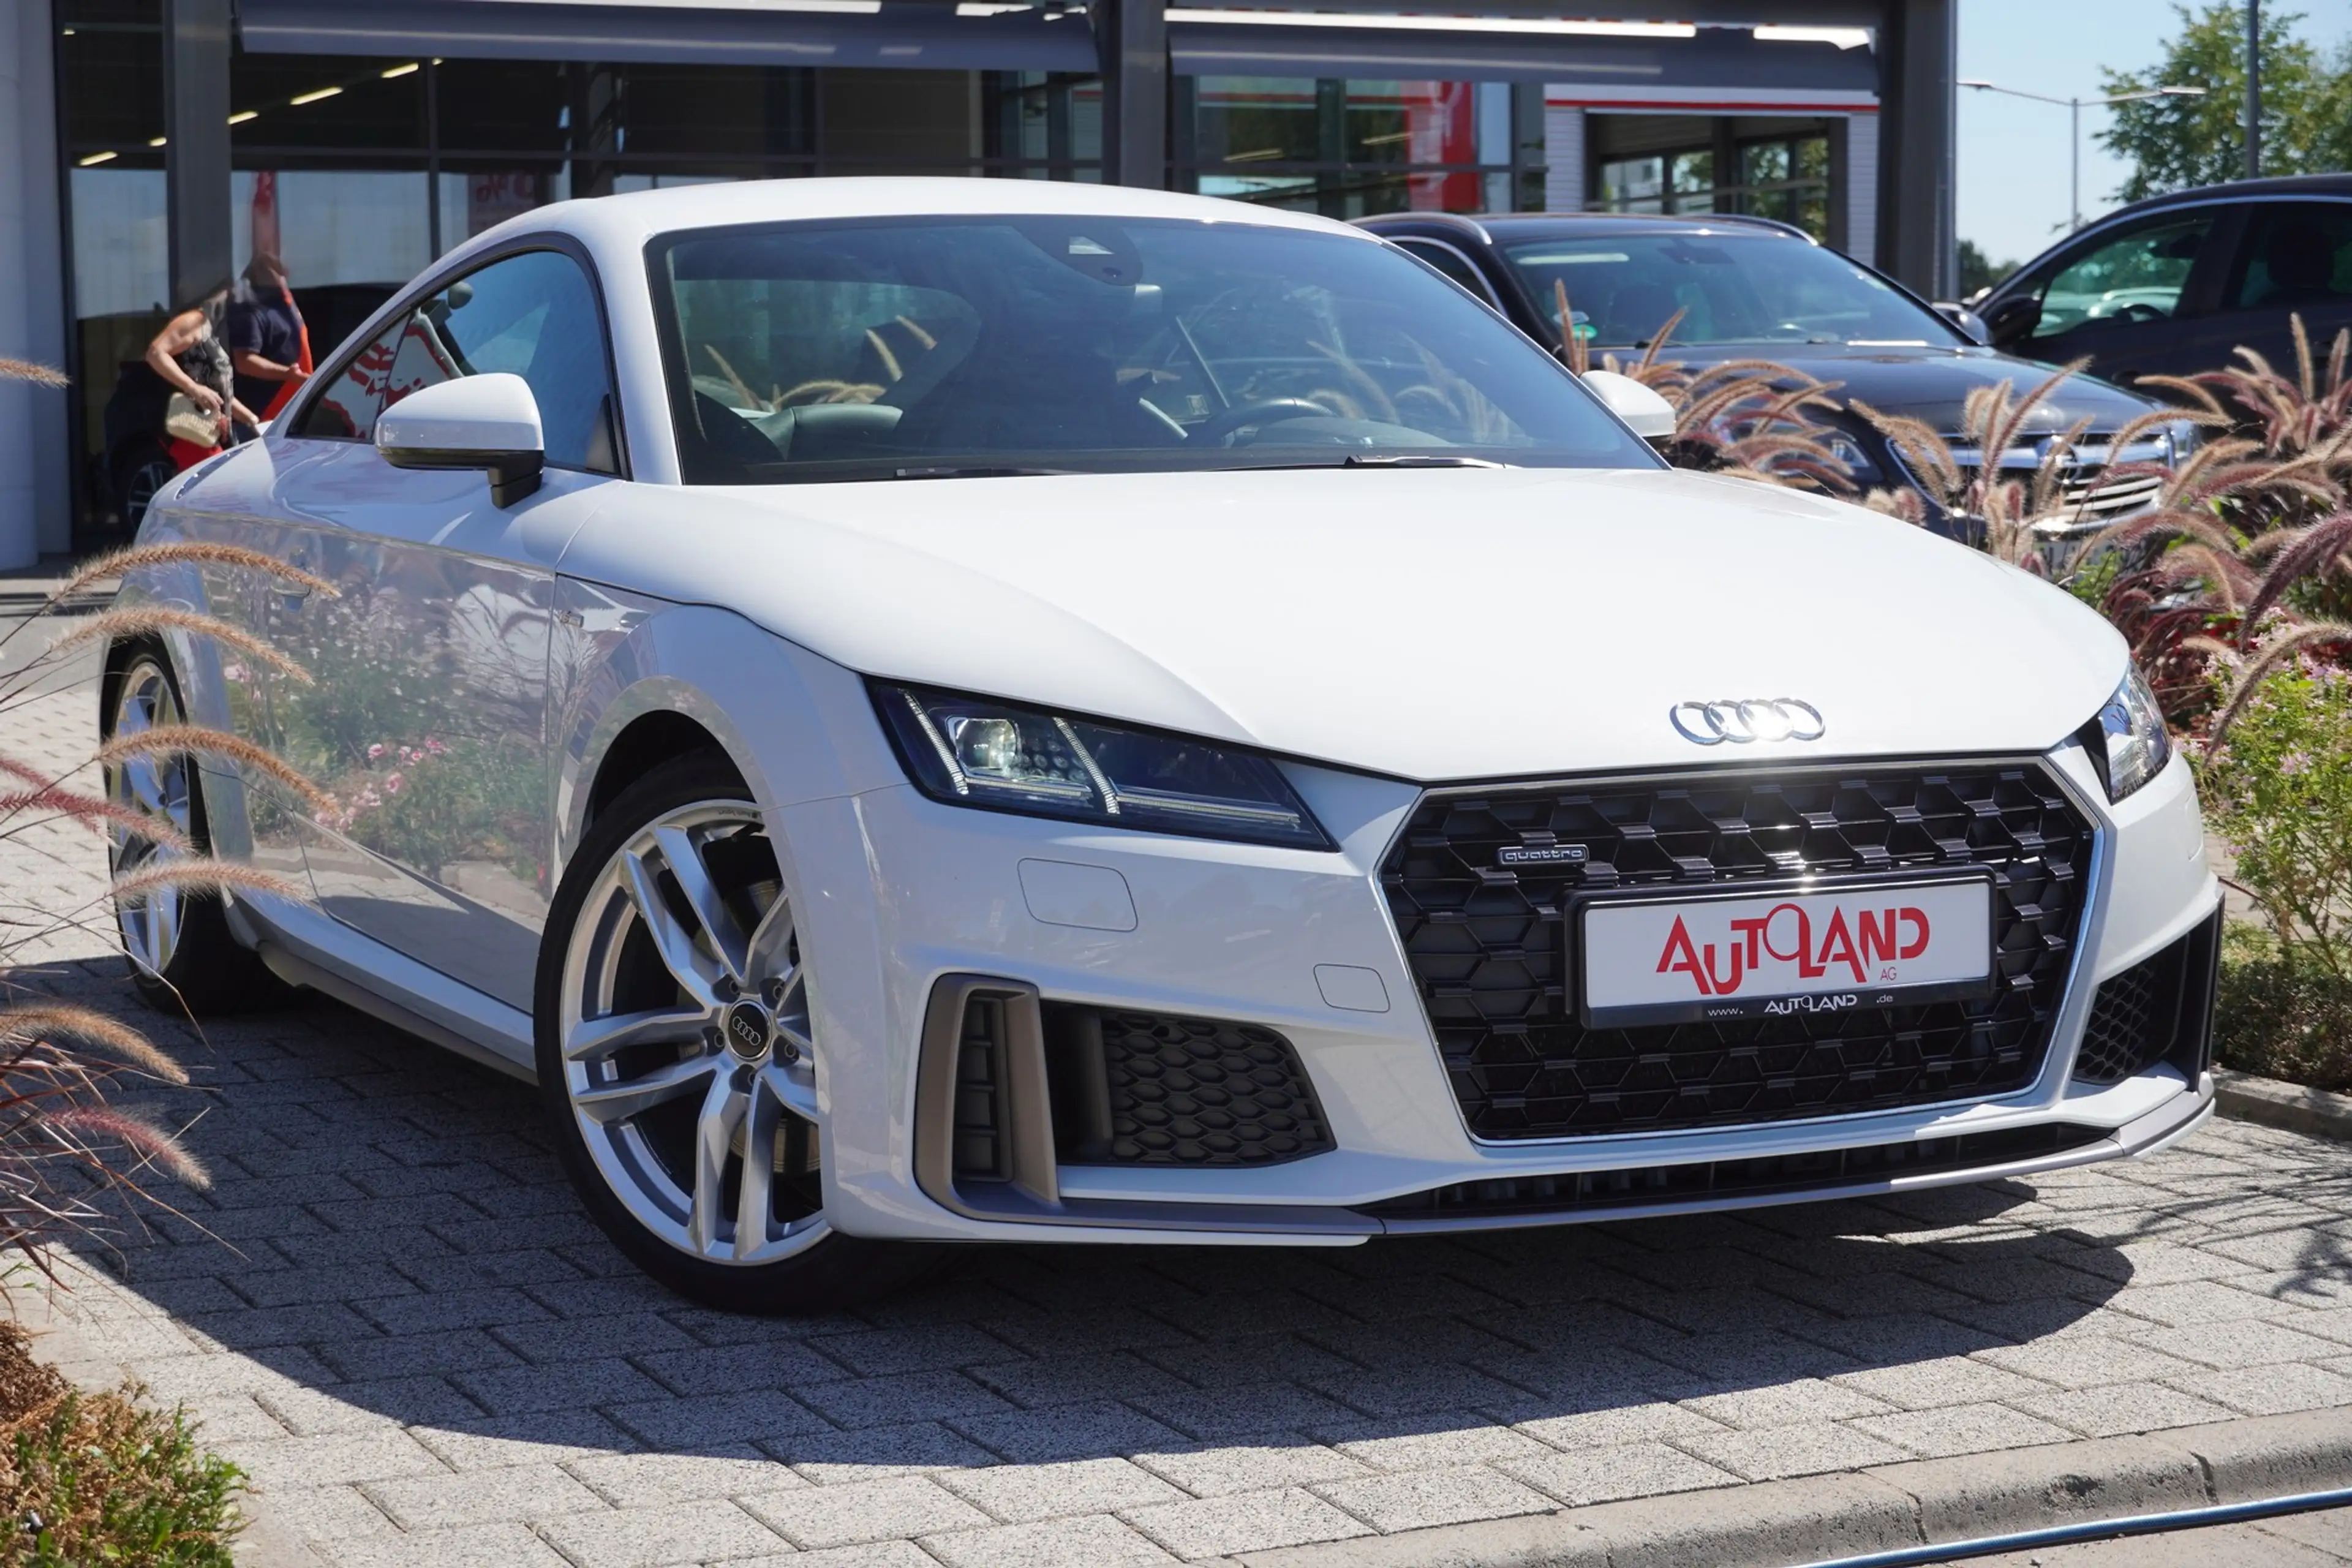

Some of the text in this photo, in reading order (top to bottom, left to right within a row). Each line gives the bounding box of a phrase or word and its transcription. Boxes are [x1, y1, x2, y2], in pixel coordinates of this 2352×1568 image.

[1505, 850, 1583, 861] quattro
[1656, 903, 1930, 995] AUTOLAND
[1880, 967, 1898, 981] AG
[1708, 993, 1893, 1017] www. AUTOLAND .de
